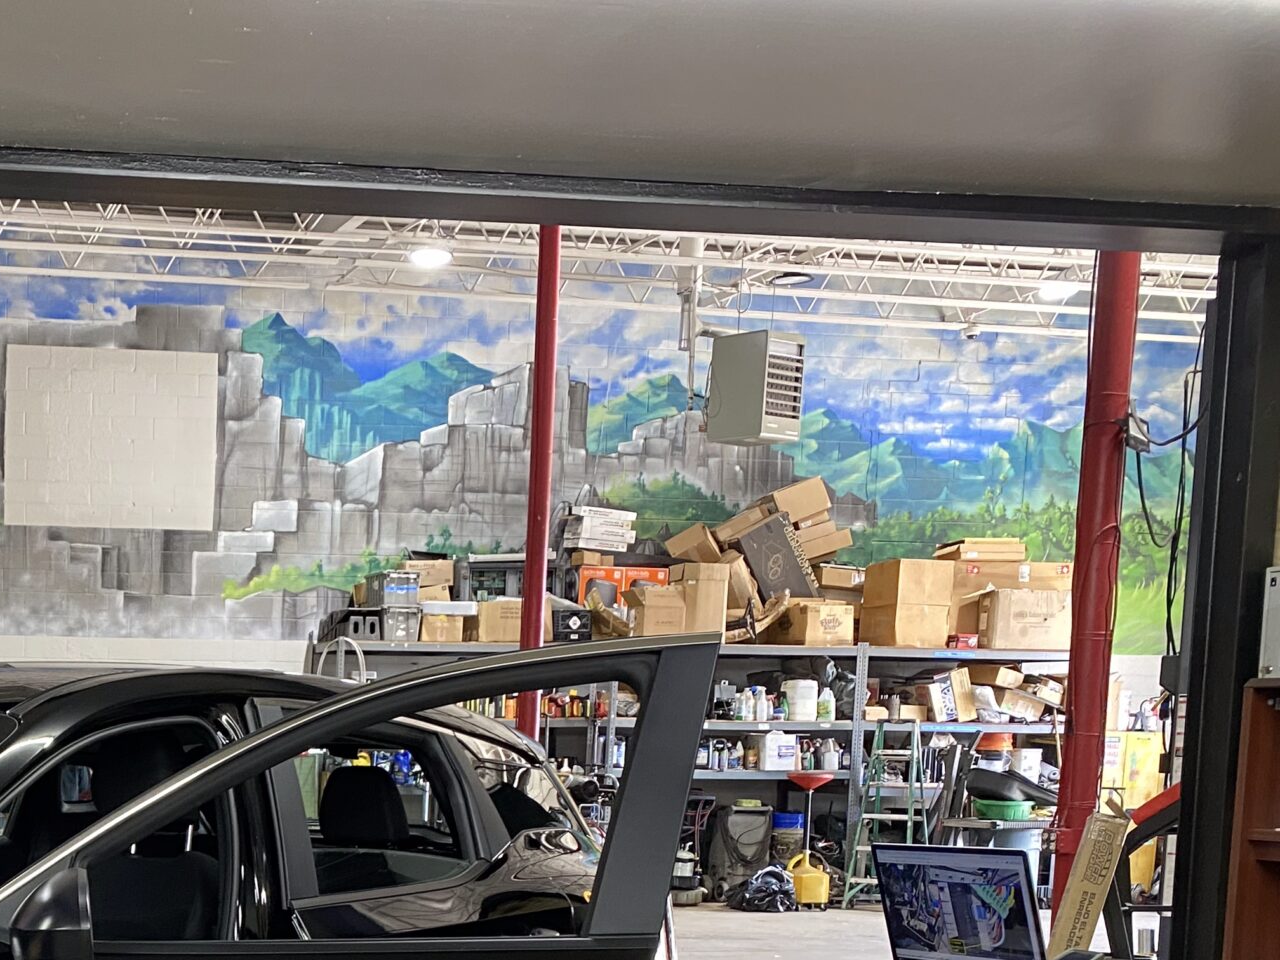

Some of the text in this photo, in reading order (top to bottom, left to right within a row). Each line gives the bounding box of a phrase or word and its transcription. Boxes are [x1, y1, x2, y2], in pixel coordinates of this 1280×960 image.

[1090, 830, 1114, 885] POWER
[1082, 892, 1096, 919] BAJO
[1079, 921, 1087, 933] EL
